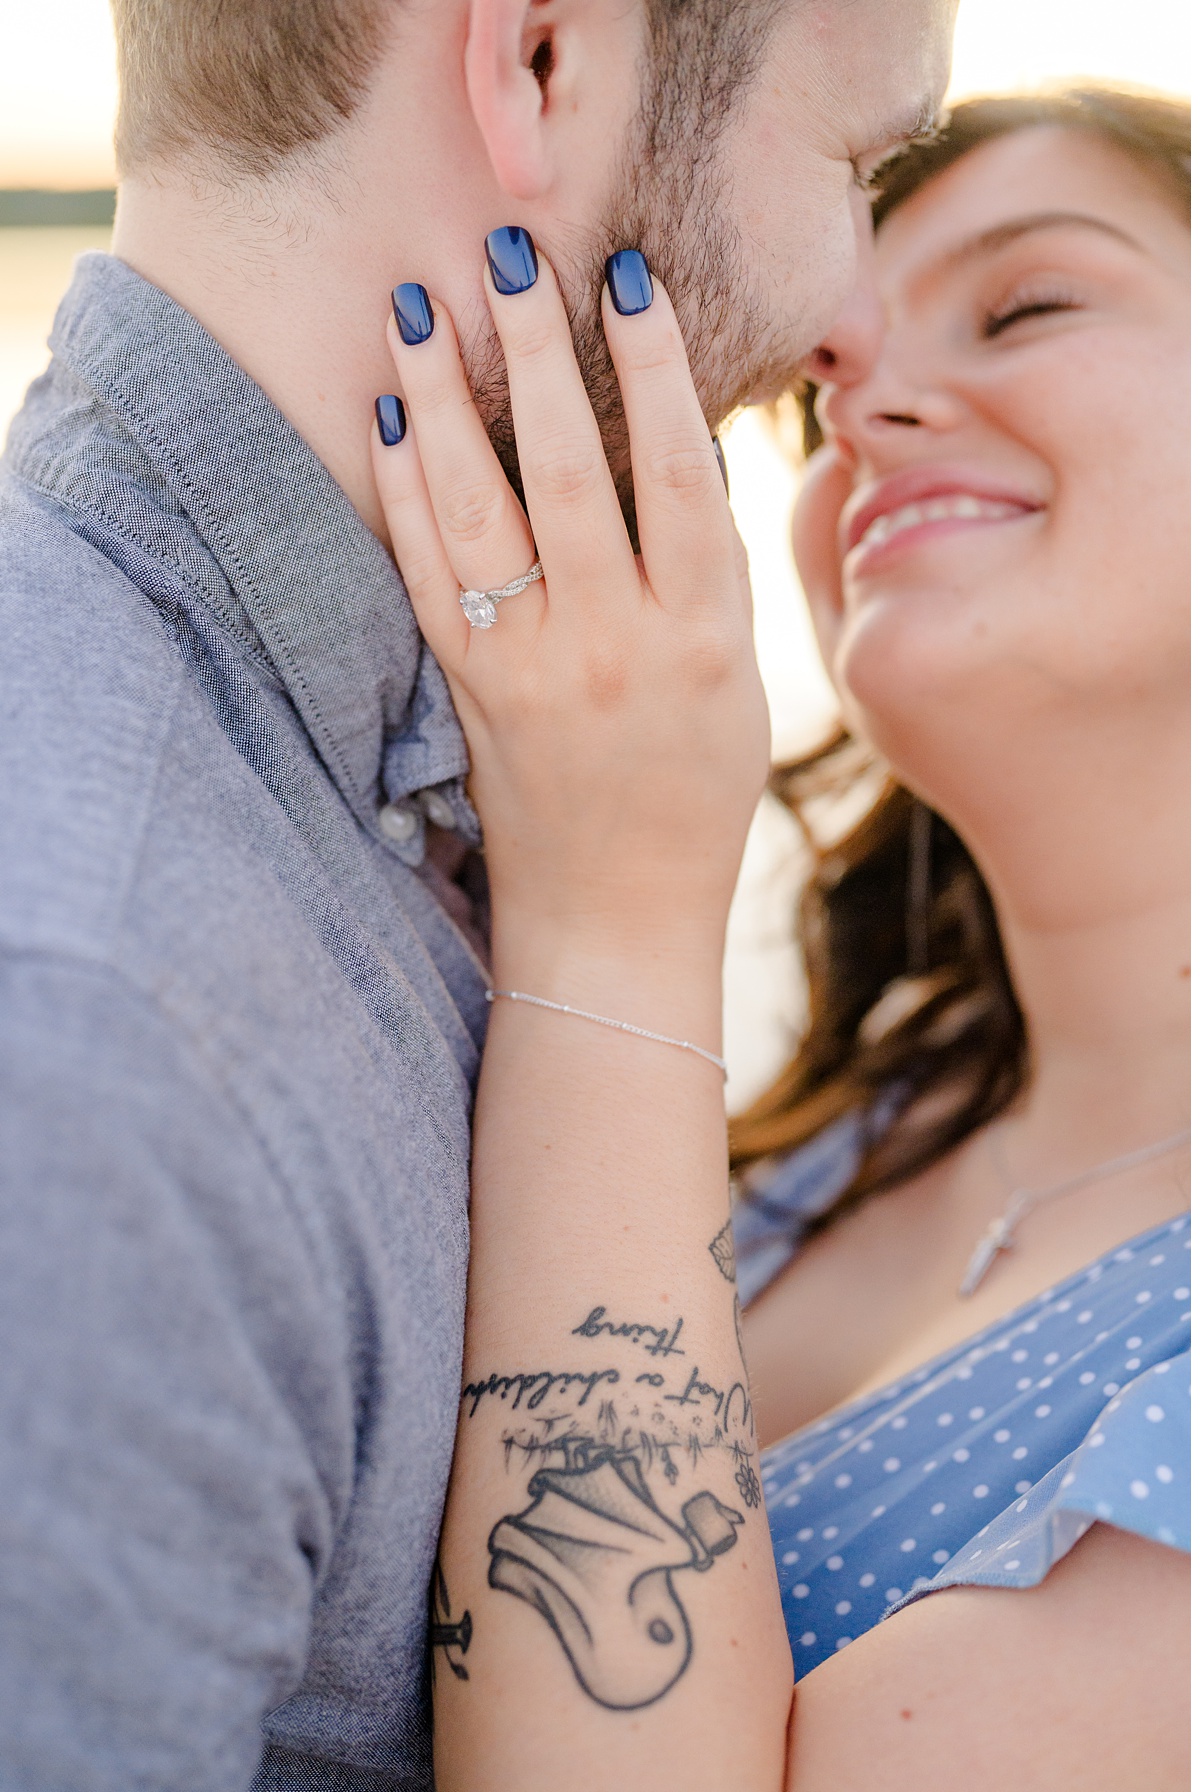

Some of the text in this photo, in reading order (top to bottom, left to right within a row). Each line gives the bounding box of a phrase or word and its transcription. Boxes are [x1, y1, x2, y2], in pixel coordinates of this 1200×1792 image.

[462, 1366, 754, 1437] What a childish
